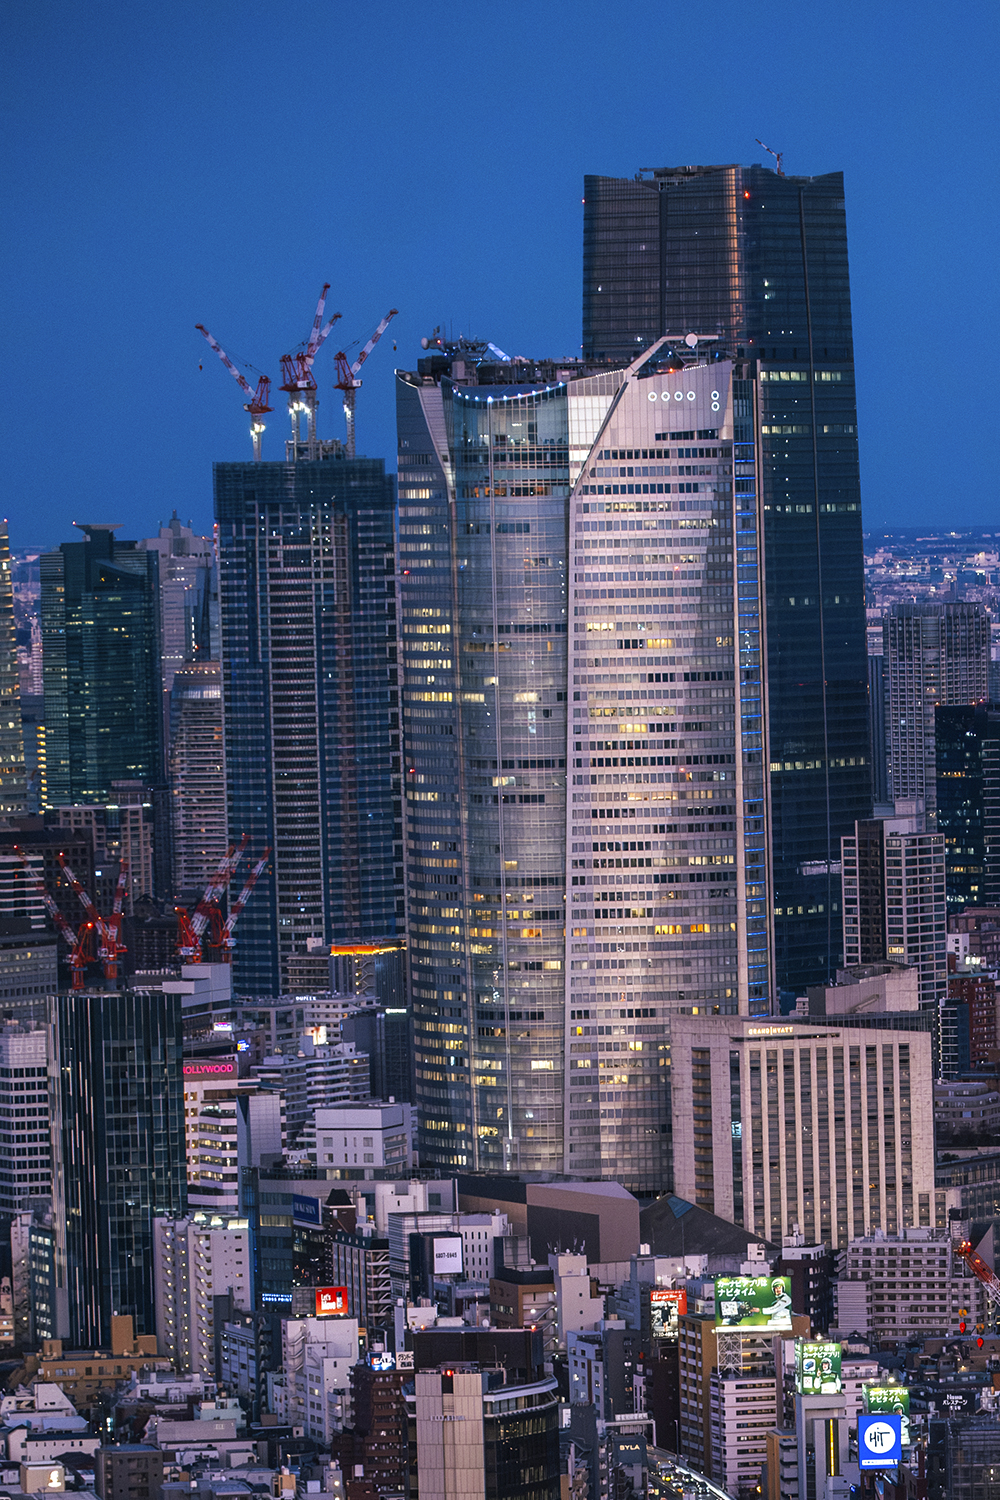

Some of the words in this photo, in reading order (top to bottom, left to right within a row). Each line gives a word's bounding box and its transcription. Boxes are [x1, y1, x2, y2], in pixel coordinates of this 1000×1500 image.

[717, 1288, 756, 1297] ナビタイム
